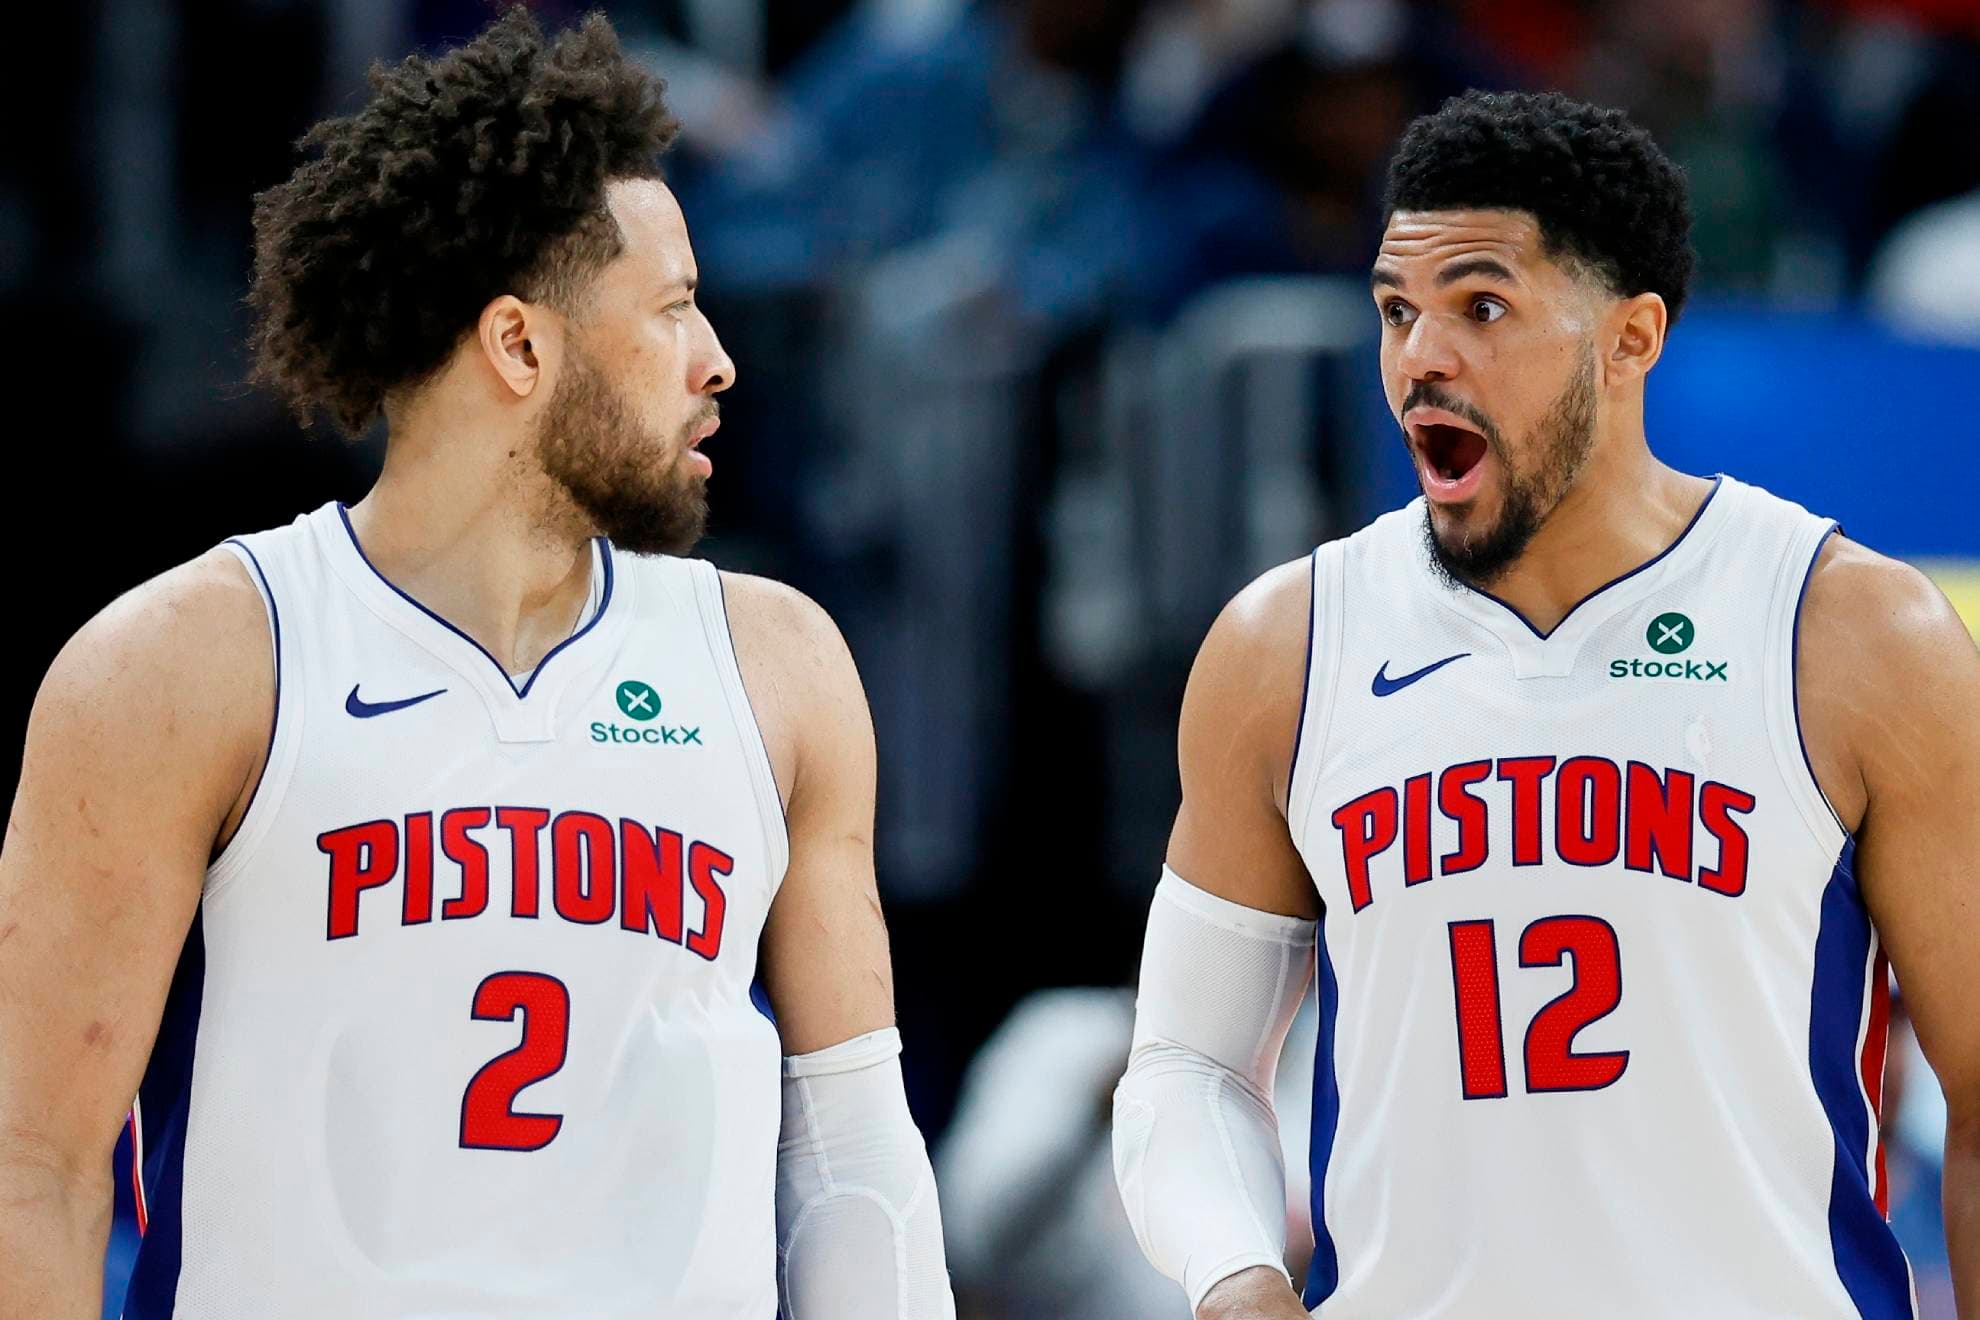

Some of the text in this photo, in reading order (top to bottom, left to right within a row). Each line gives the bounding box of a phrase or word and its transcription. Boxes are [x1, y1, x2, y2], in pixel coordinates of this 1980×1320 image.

[590, 721, 704, 746] StockX
[1609, 658, 1728, 682] StockX
[317, 805, 735, 961] PISTONS
[1331, 755, 1757, 911] PISTONS
[459, 970, 571, 1151] 2
[1448, 914, 1630, 1100] 12
